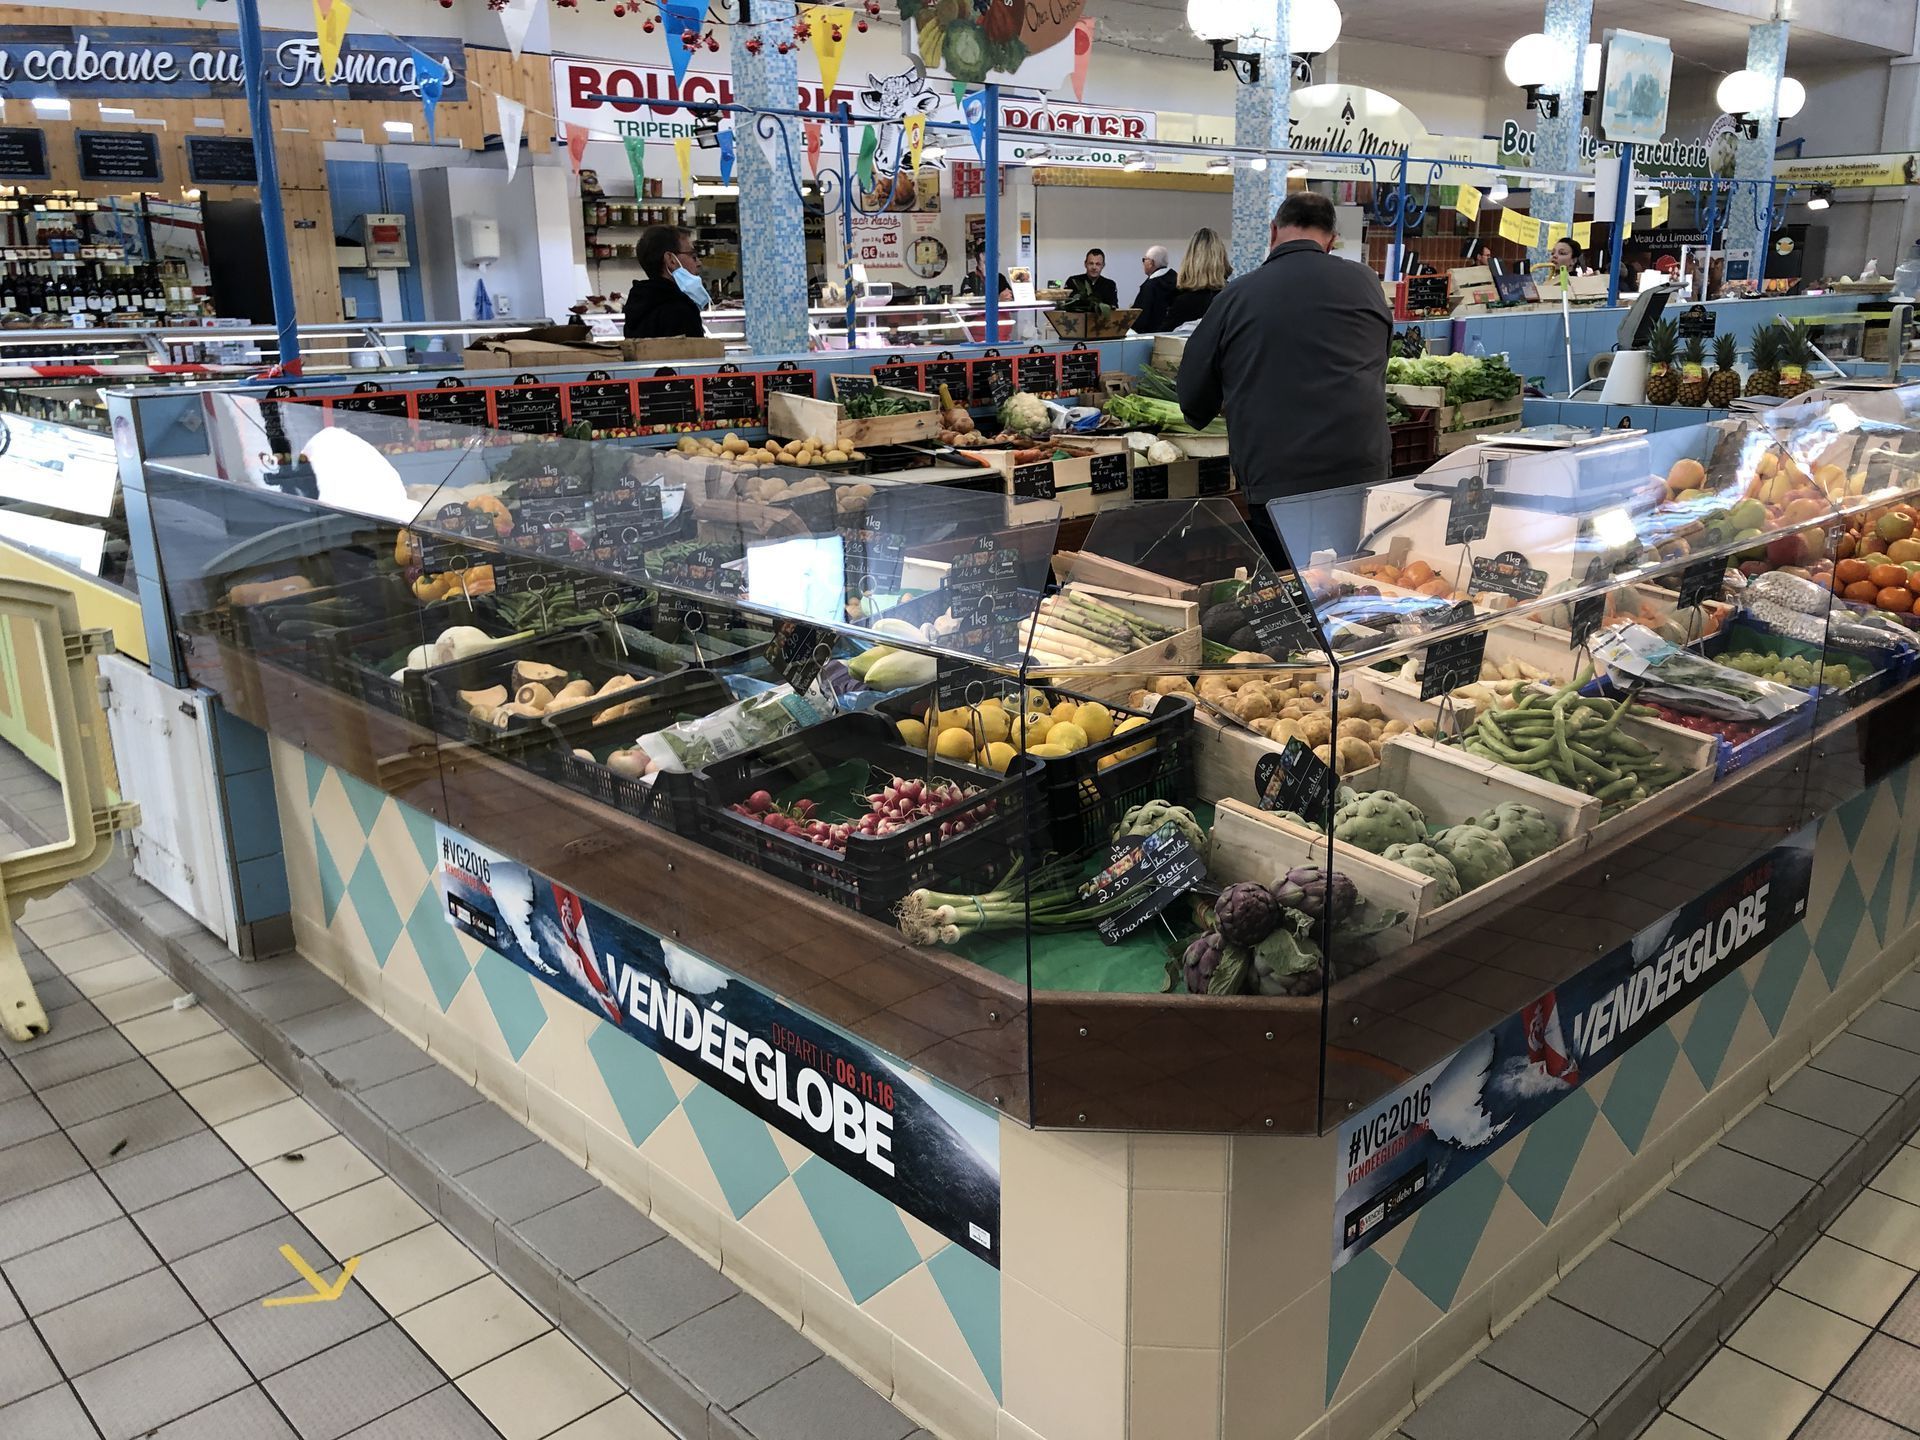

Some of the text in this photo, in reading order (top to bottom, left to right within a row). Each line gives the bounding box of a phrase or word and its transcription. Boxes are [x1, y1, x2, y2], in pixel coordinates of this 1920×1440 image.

[24, 34, 182, 81] cabane
[277, 38, 455, 97] Fromags
[568, 65, 854, 126] BOUCHRIE
[1449, 153, 1474, 170] MIEL
[1634, 231, 1708, 243] Veau du Limousin
[863, 247, 876, 258] 8€
[723, 365, 735, 373] 1kg
[521, 376, 534, 385] 1kg
[593, 372, 606, 381] 1kg
[785, 376, 793, 385] €
[363, 383, 378, 393] 1kg
[443, 378, 457, 388] 1kg
[664, 382, 672, 392] €
[727, 379, 734, 388] €
[274, 388, 290, 398] 1kg
[525, 391, 534, 400] €
[597, 387, 605, 396] €
[449, 394, 458, 404] €
[368, 400, 377, 410] €
[543, 465, 558, 476] 1kg
[619, 477, 635, 488] 1kg
[445, 505, 461, 517] 1kg
[865, 515, 881, 530] 1kg
[520, 523, 538, 534] 1kg
[979, 537, 994, 550] 1kg
[697, 552, 714, 566] 1kg
[1505, 552, 1521, 565] 1kg
[1511, 577, 1519, 585] €
[1280, 595, 1290, 604] €
[969, 613, 988, 626] 1kg
[984, 645, 992, 653] €
[1286, 775, 1295, 787] €
[1110, 844, 1131, 862] Pièce
[1111, 845, 1121, 853] la
[443, 836, 491, 884] #VG2016
[1097, 858, 1152, 904] 2,50 €
[1572, 882, 1770, 1060] VENDÉEGLOBE
[605, 952, 896, 1178] VENDÉEGLOBE
[818, 1052, 833, 1077] LE
[836, 1057, 895, 1111] 06.11.16
[1348, 1082, 1432, 1169] #VG2016
